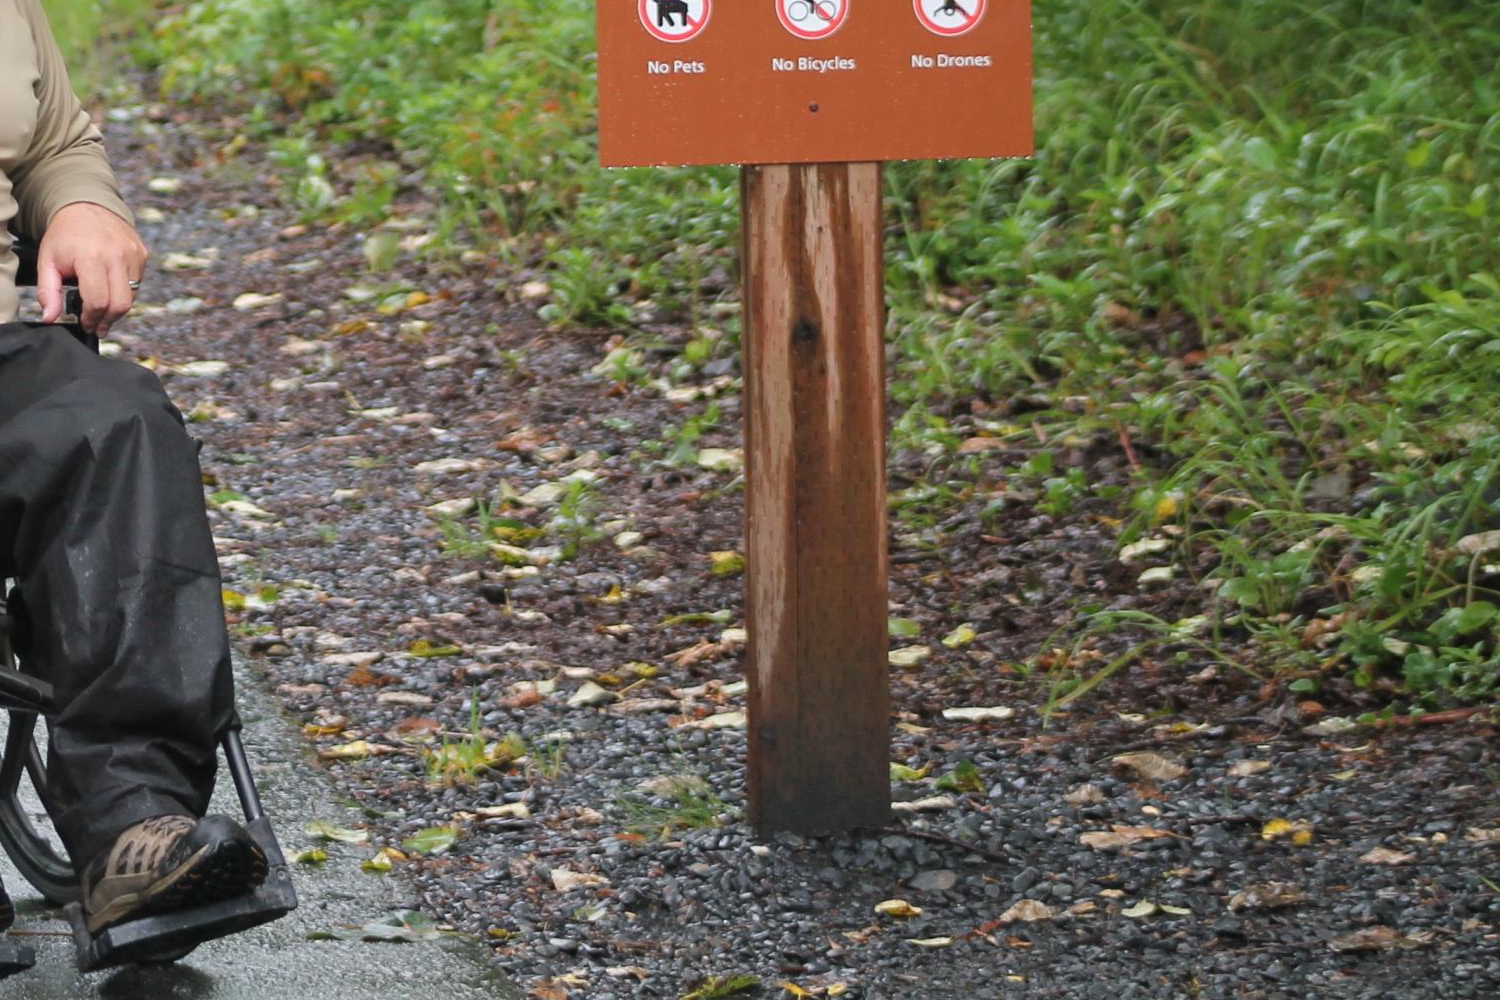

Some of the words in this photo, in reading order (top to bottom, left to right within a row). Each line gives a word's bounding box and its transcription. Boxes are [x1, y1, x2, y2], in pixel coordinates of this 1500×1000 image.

[647, 60, 670, 75] No
[672, 59, 705, 75] Pets
[771, 56, 795, 71] No
[797, 55, 856, 75] Bicycles
[910, 53, 933, 68] No
[936, 52, 991, 68] Drones
